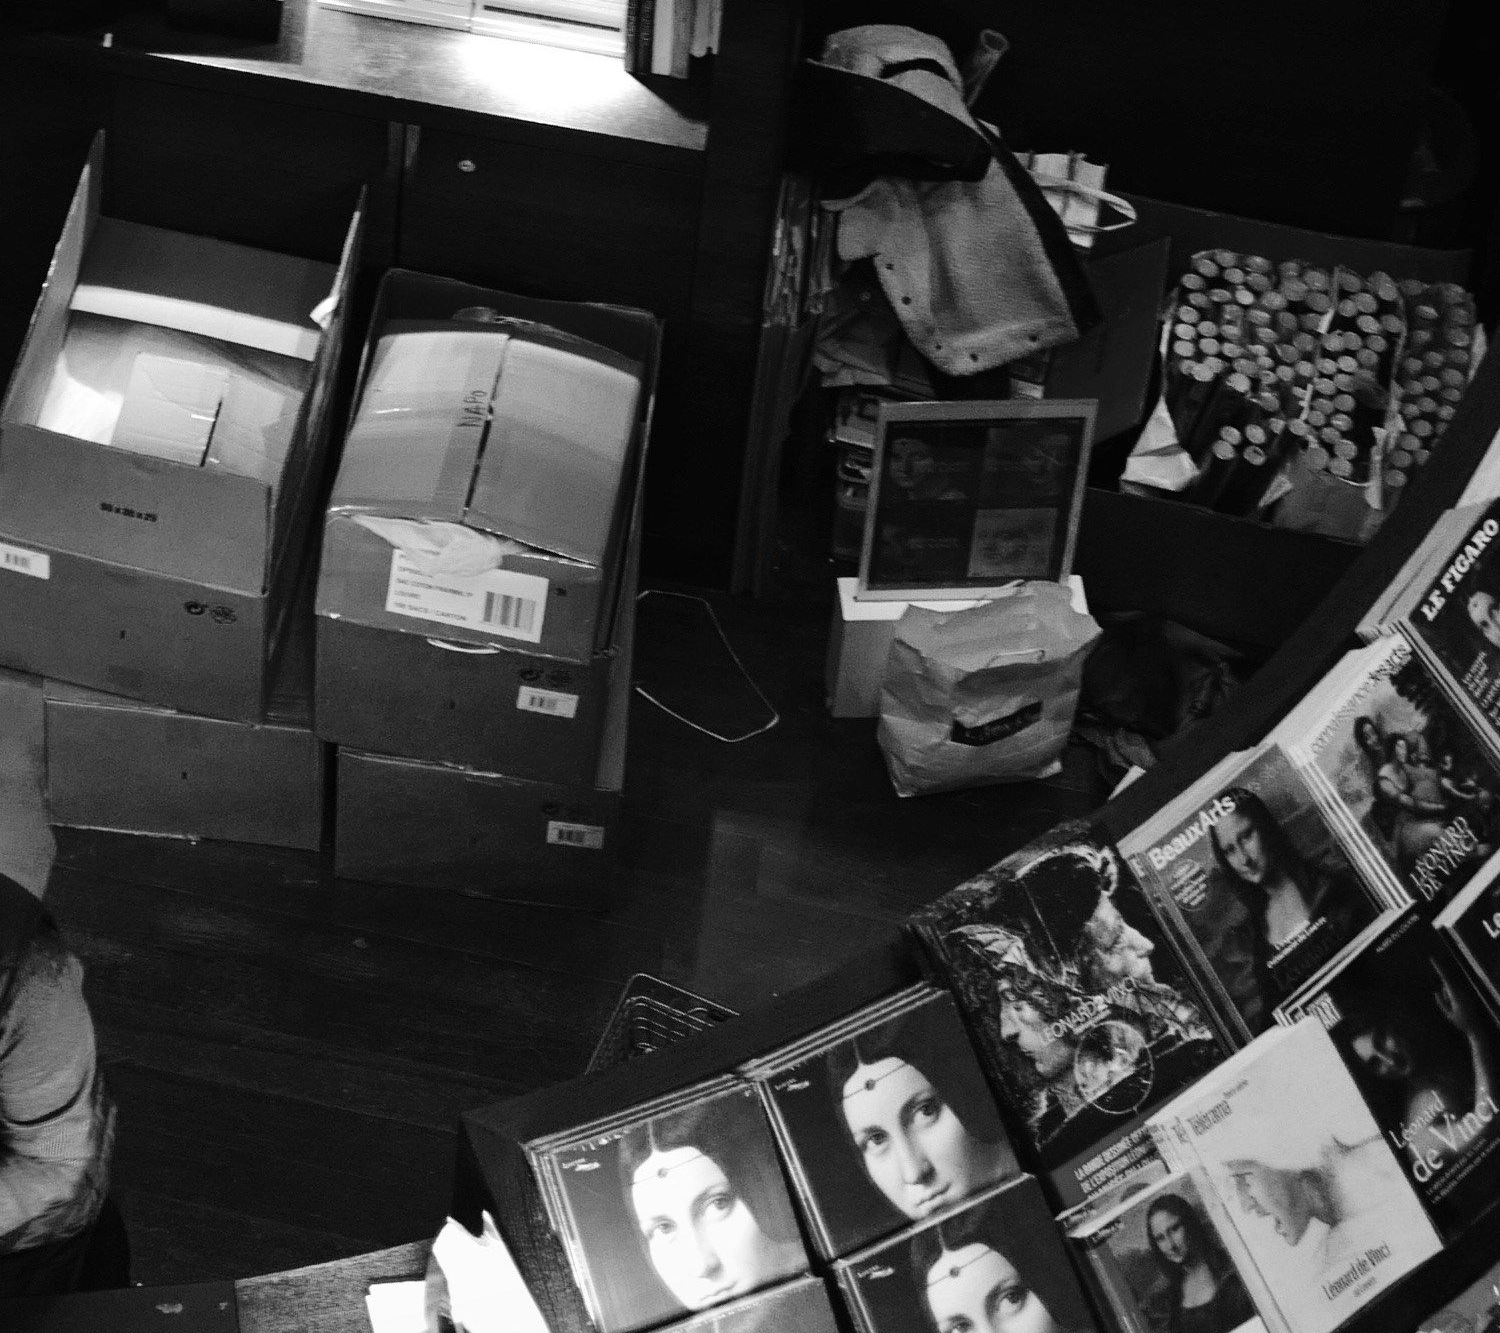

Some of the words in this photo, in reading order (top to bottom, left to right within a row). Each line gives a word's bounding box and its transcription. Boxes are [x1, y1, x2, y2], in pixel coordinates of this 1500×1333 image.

[1419, 589, 1447, 622] LE
[1437, 516, 1500, 594] FIGARO
[1145, 793, 1237, 872] BeauxArts
[1438, 828, 1477, 875] VINCI
[1388, 1090, 1445, 1149] Léonard
[1408, 1141, 1444, 1180] de
[1428, 1094, 1498, 1150] Vinci
[1364, 1240, 1392, 1267] Vinci
